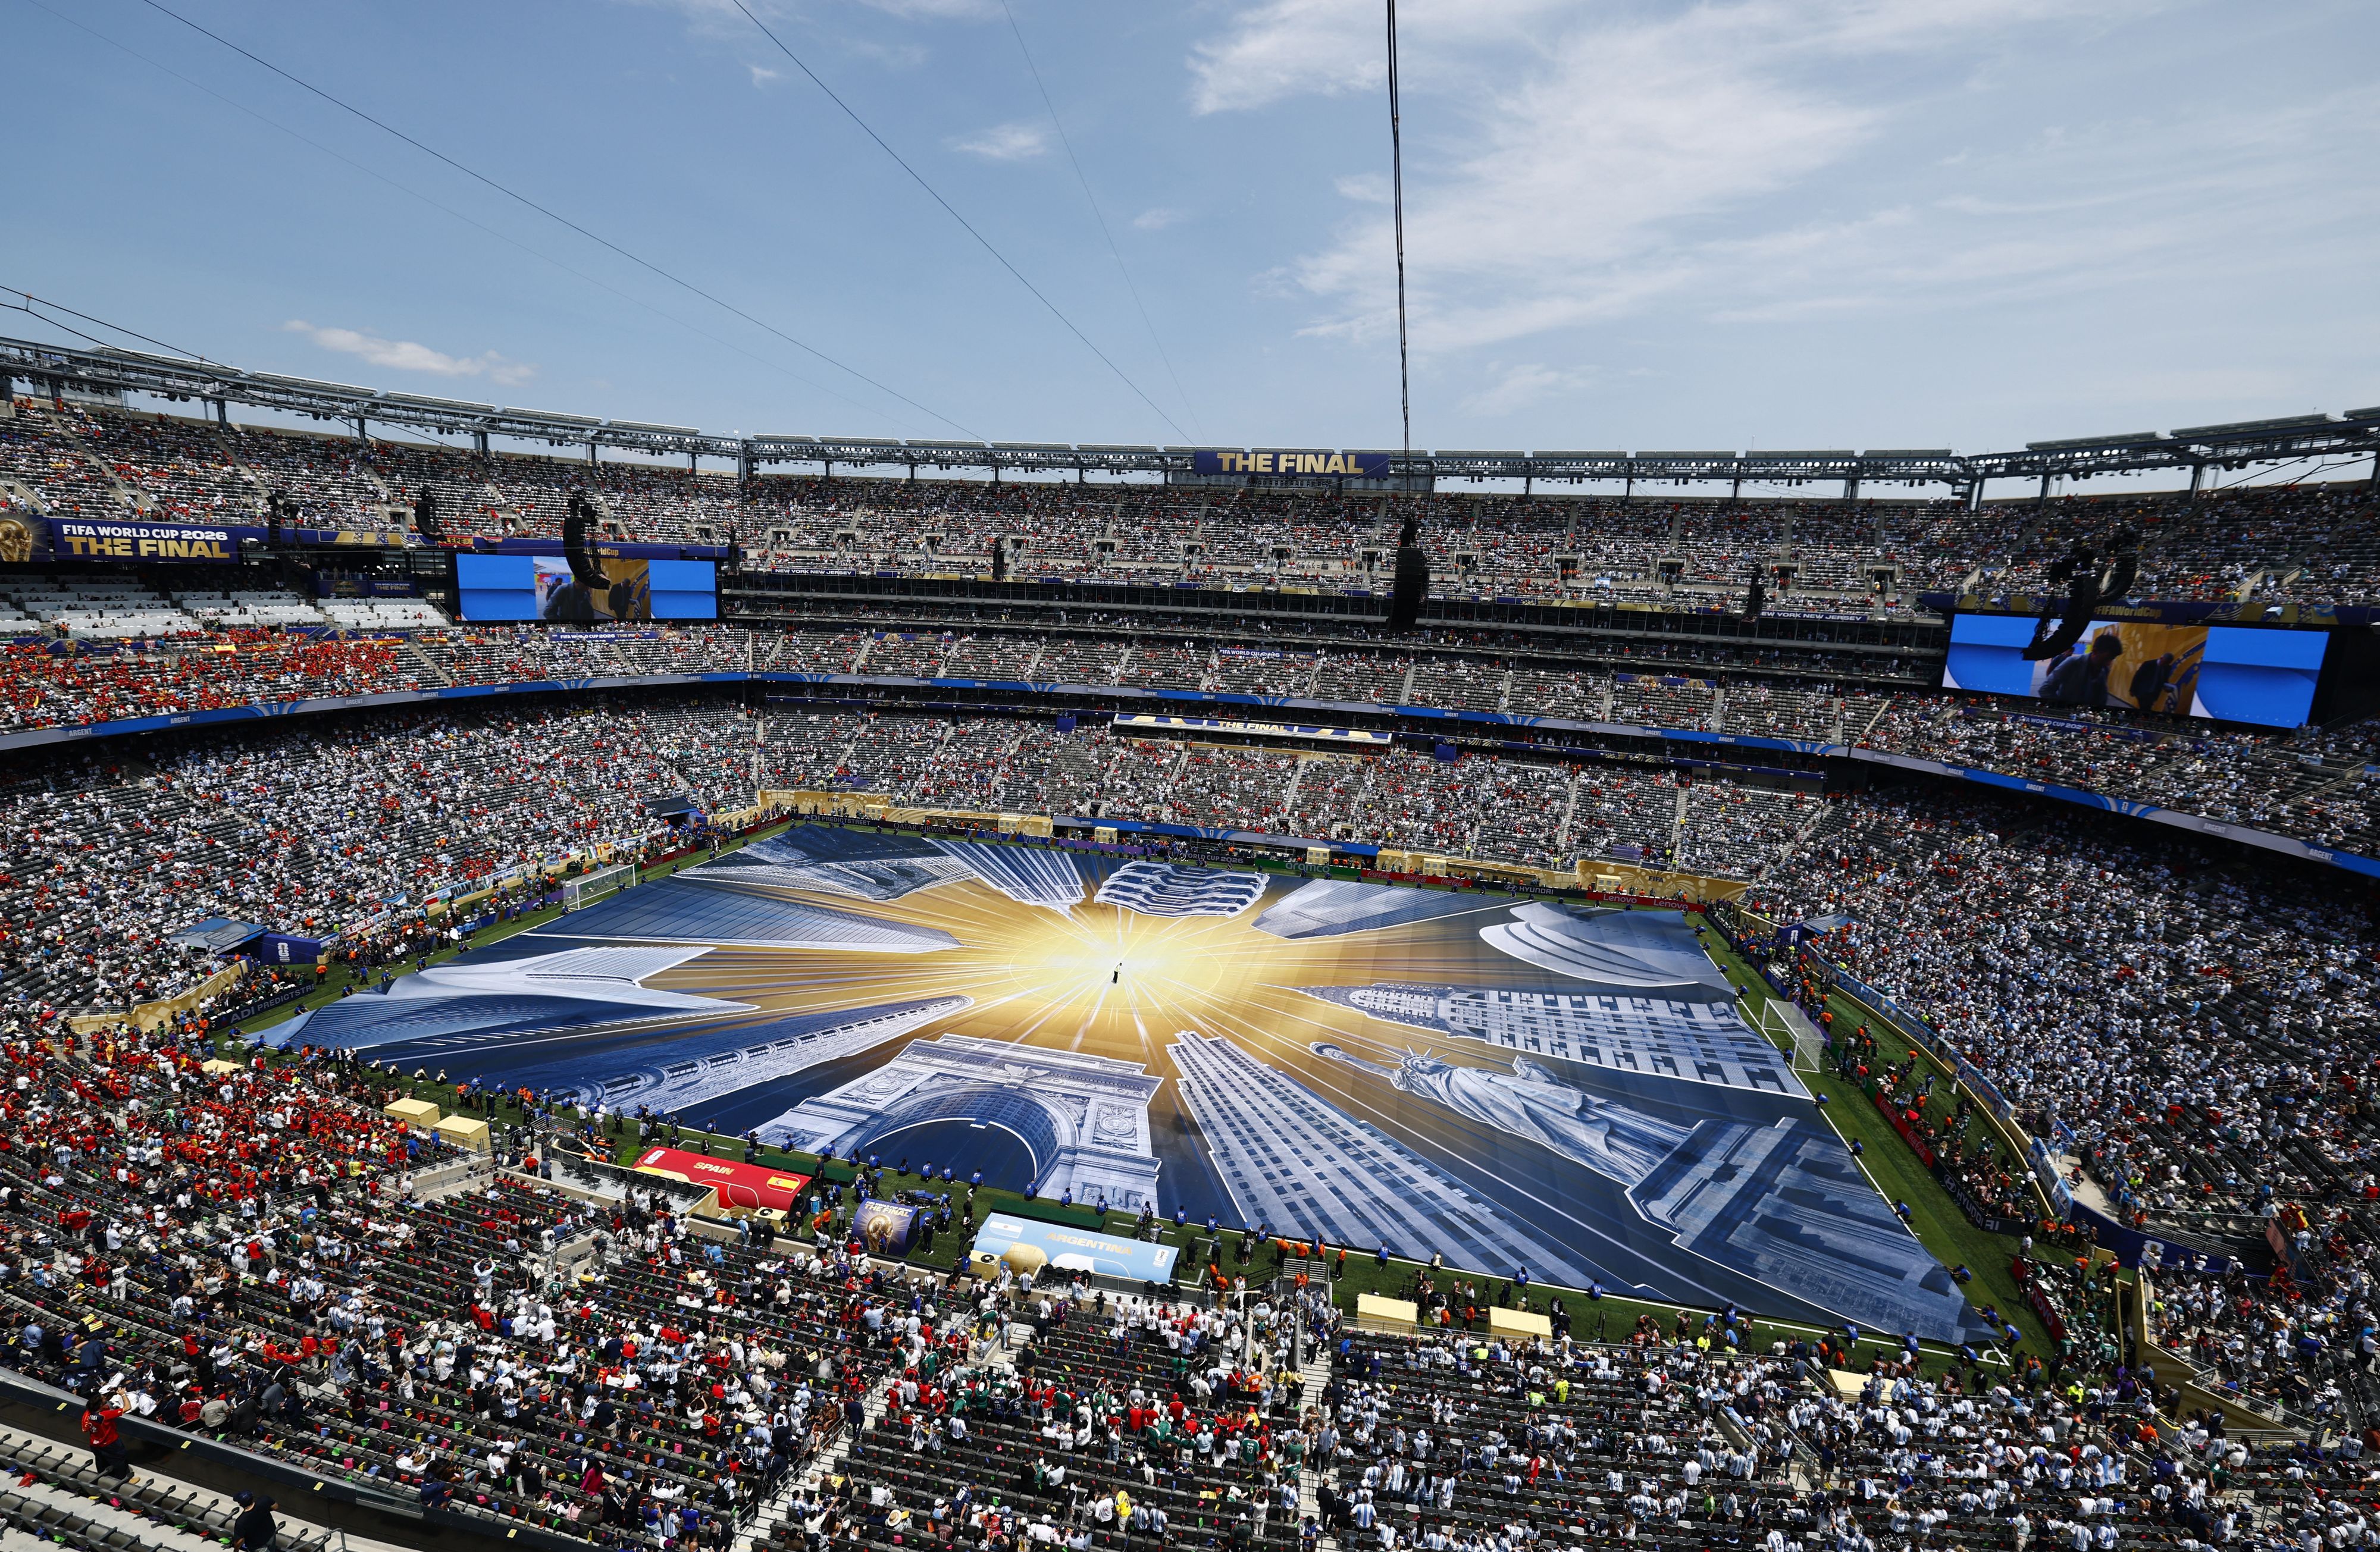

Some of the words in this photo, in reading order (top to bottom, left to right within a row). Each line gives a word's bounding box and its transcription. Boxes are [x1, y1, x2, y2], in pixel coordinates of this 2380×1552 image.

[1217, 453, 1273, 472] THE
[1278, 454, 1363, 474] FINAL
[62, 525, 95, 535] FIFA
[97, 526, 149, 538] WORLD
[151, 528, 179, 539] CUP
[180, 530, 228, 541] 2026
[64, 537, 133, 556] THE
[139, 540, 230, 559] FINAL
[170, 716, 190, 724] ARGENT
[1217, 720, 1244, 729] THE
[1246, 722, 1289, 732] FINAL
[69, 728, 92, 737] ARGENT
[1947, 767, 1964, 776] ARGENT
[2025, 783, 2045, 792] ARGENT
[757, 820, 777, 831] Lenovo
[822, 816, 870, 826] PREDICTSTREET
[893, 822, 917, 831] QATAR
[919, 826, 950, 834] AIRWAYS
[2203, 823, 2226, 833] ARGENT
[984, 832, 1002, 840] VISA
[1023, 836, 1042, 844] VISA
[2309, 848, 2334, 861] ARGENT
[1285, 862, 1330, 873] aramco
[1519, 887, 1554, 895] HYUNDAI
[1603, 894, 1637, 904] Lenovo
[1654, 898, 1689, 910] Lenovo
[1771, 976, 1782, 993] VISA
[230, 1007, 255, 1023] ADI
[693, 1162, 735, 1175] SPAIN
[865, 1203, 882, 1213] THE
[882, 1206, 910, 1218] FINAL
[1957, 1190, 1999, 1231] HYUNDAI
[1045, 1232, 1132, 1255] ARGENTINA
[1003, 1522, 1012, 1533] 19
